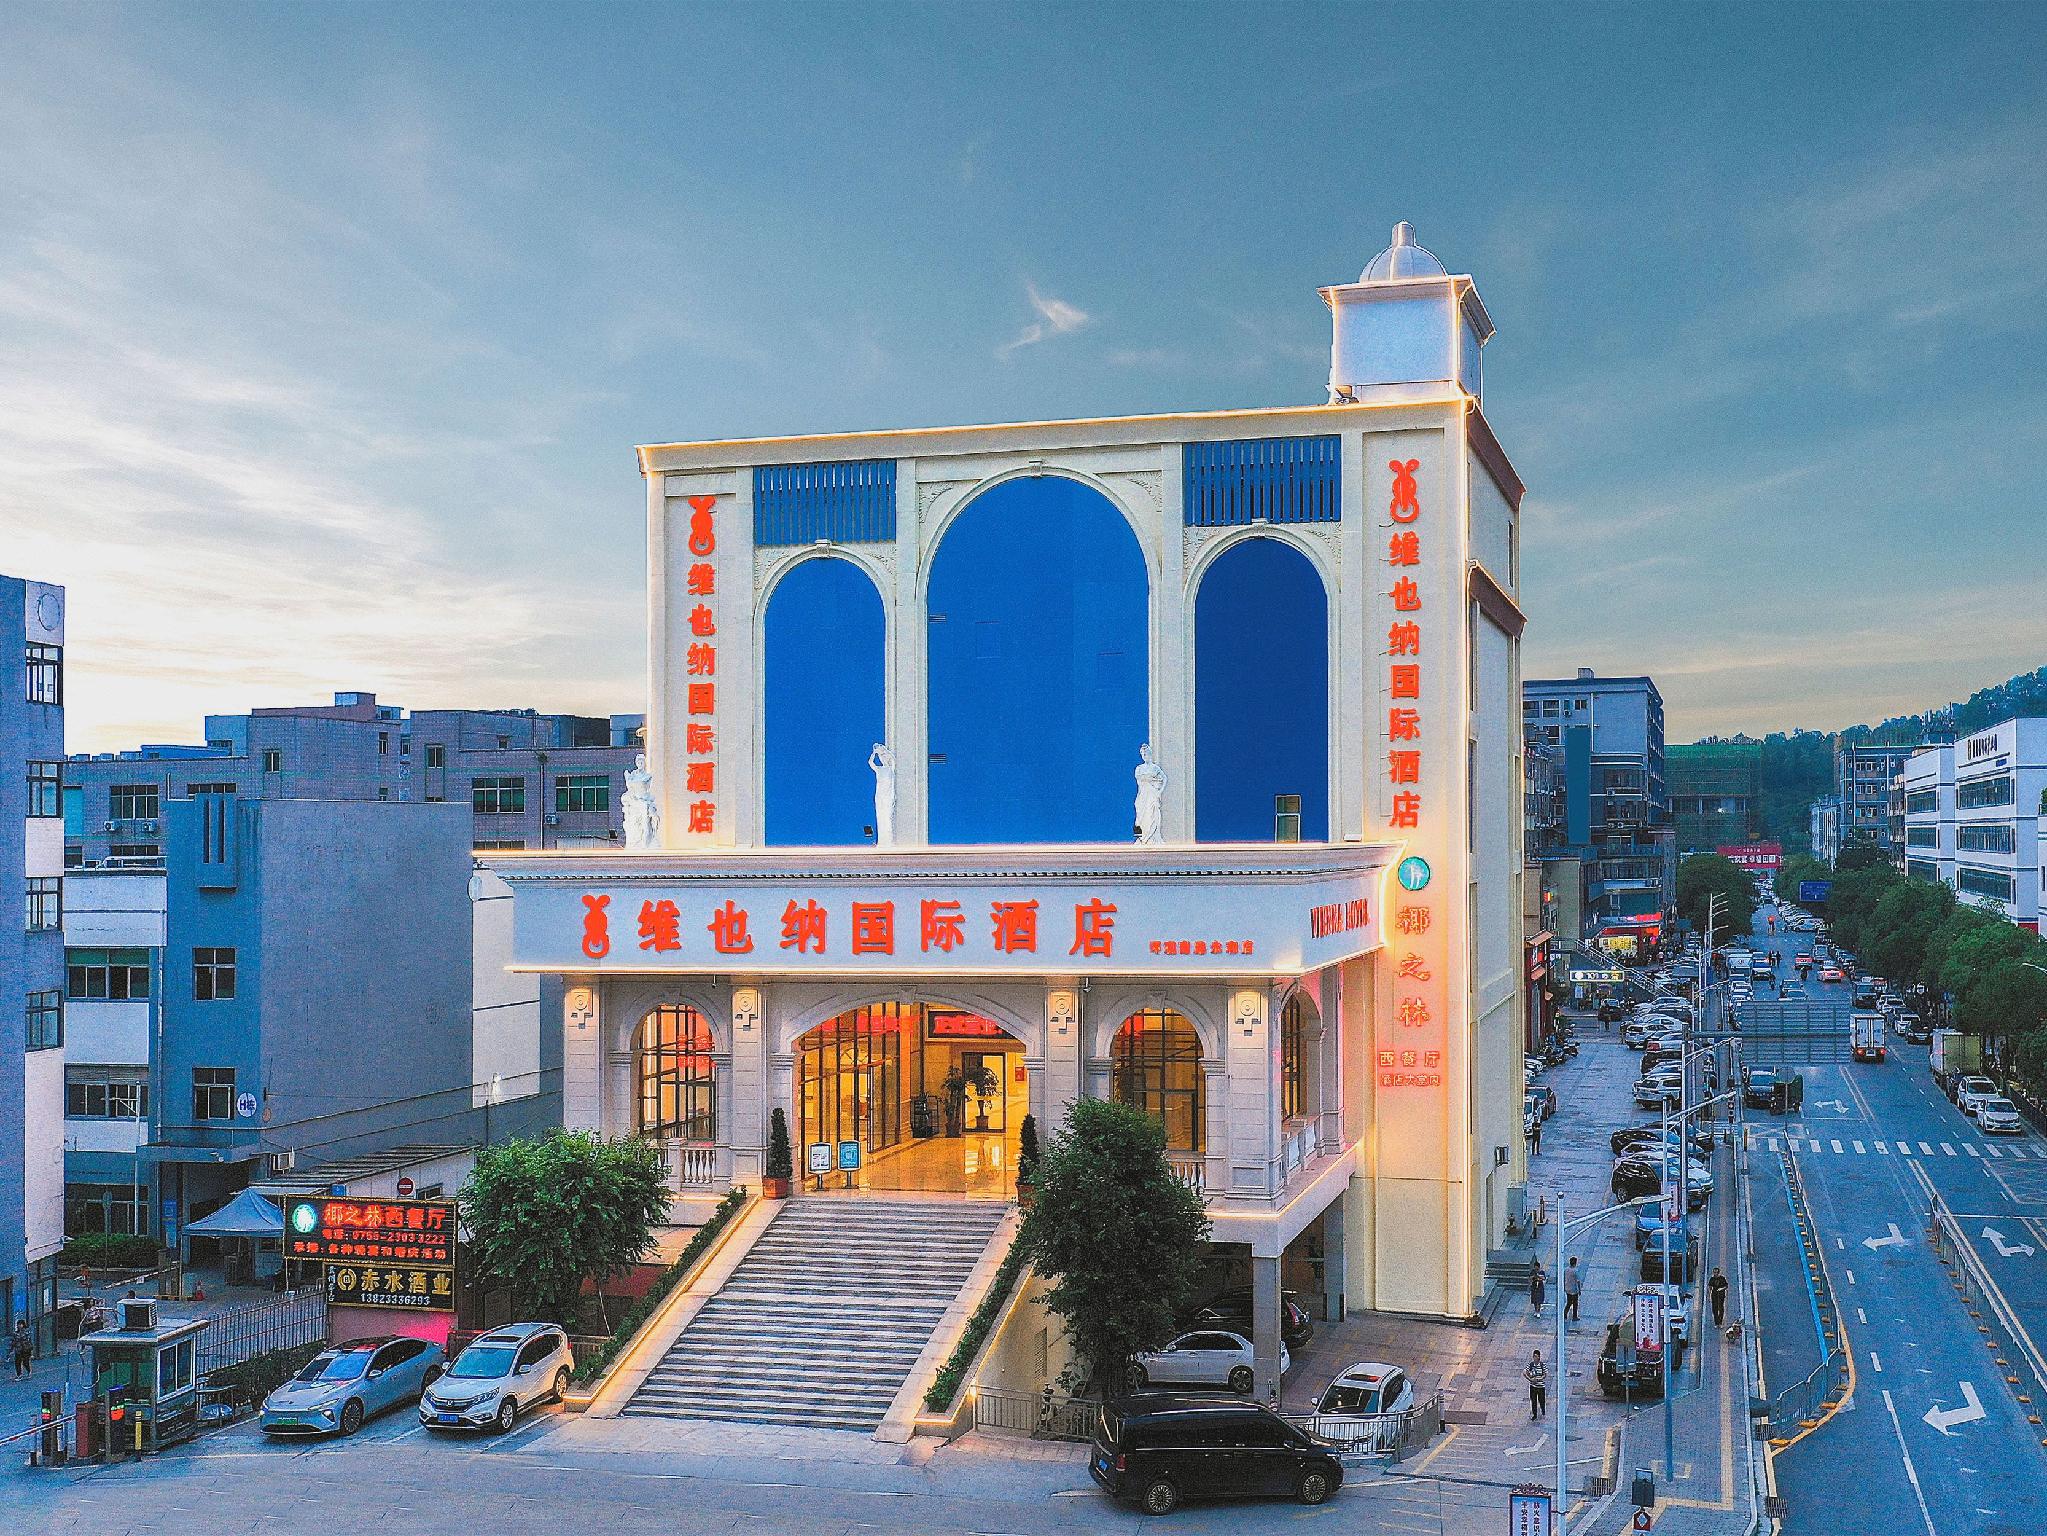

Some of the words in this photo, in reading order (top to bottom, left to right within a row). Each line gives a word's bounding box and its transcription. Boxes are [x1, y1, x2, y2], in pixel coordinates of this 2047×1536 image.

[686, 563, 716, 833] 维也纳国际酒店
[1388, 531, 1422, 829] 维也纳国际酒店
[637, 898, 1118, 958] 维也纳国际酒店
[1397, 905, 1431, 1027] 椰之林
[1378, 1050, 1440, 1068] 西餐厅
[323, 1202, 447, 1231] 椰之林西餐厅
[361, 1268, 451, 1295] 赤水酒业
